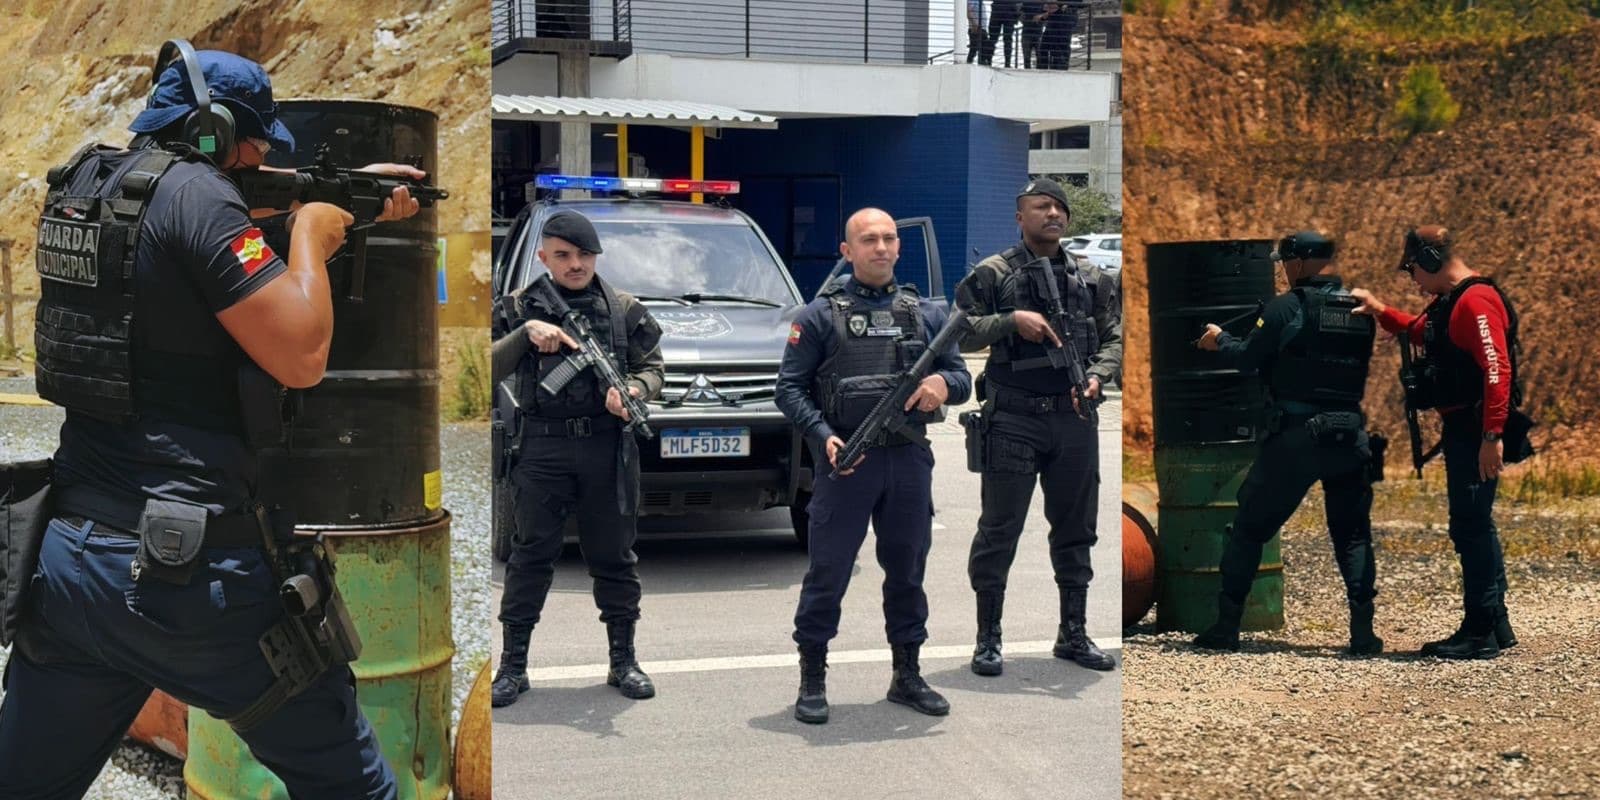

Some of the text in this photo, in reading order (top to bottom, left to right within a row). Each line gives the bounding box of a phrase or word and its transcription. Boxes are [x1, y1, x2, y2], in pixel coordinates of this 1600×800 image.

[39, 221, 95, 253] GUARDA
[38, 249, 96, 281] MUNICIPAL
[1477, 314, 1499, 384] INSTRUTOR
[670, 437, 741, 454] MLF5D32
